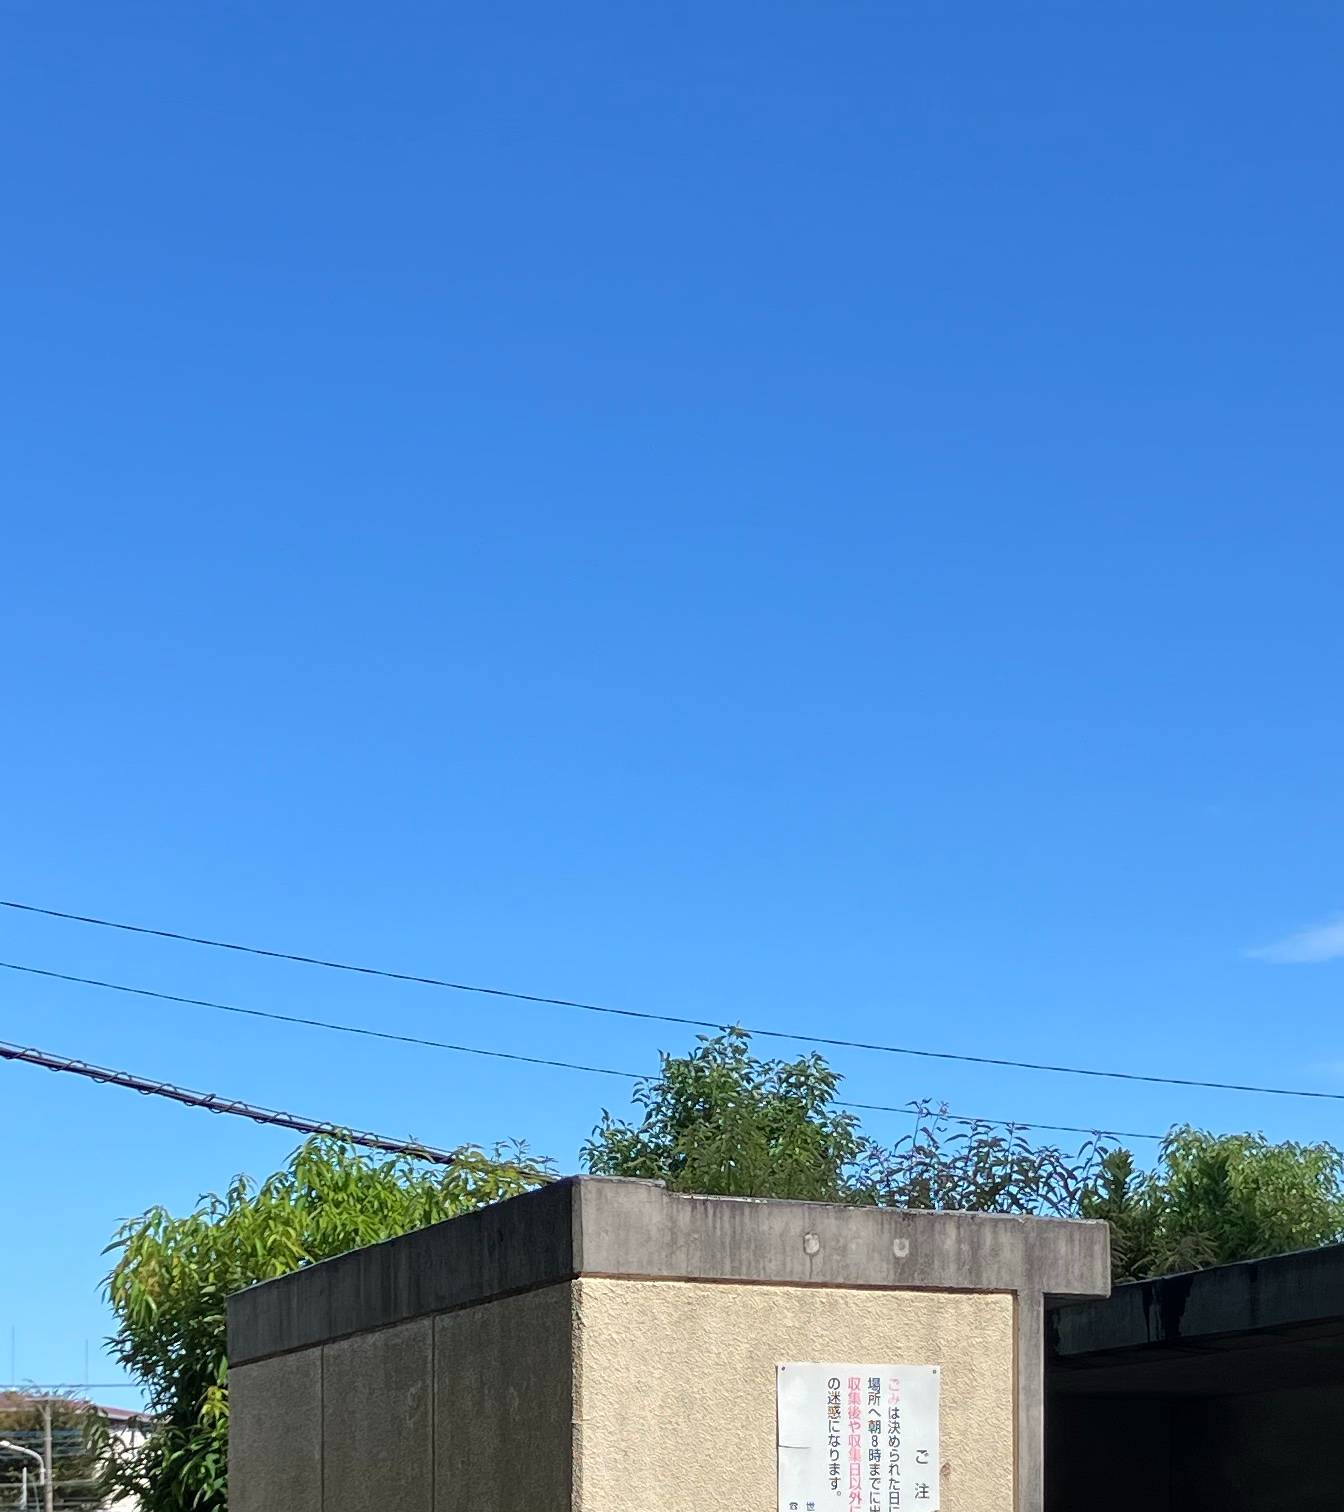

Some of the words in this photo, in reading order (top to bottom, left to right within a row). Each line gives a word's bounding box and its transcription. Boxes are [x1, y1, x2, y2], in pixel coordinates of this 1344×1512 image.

[827, 1377, 842, 1497] の迷惑になります。
